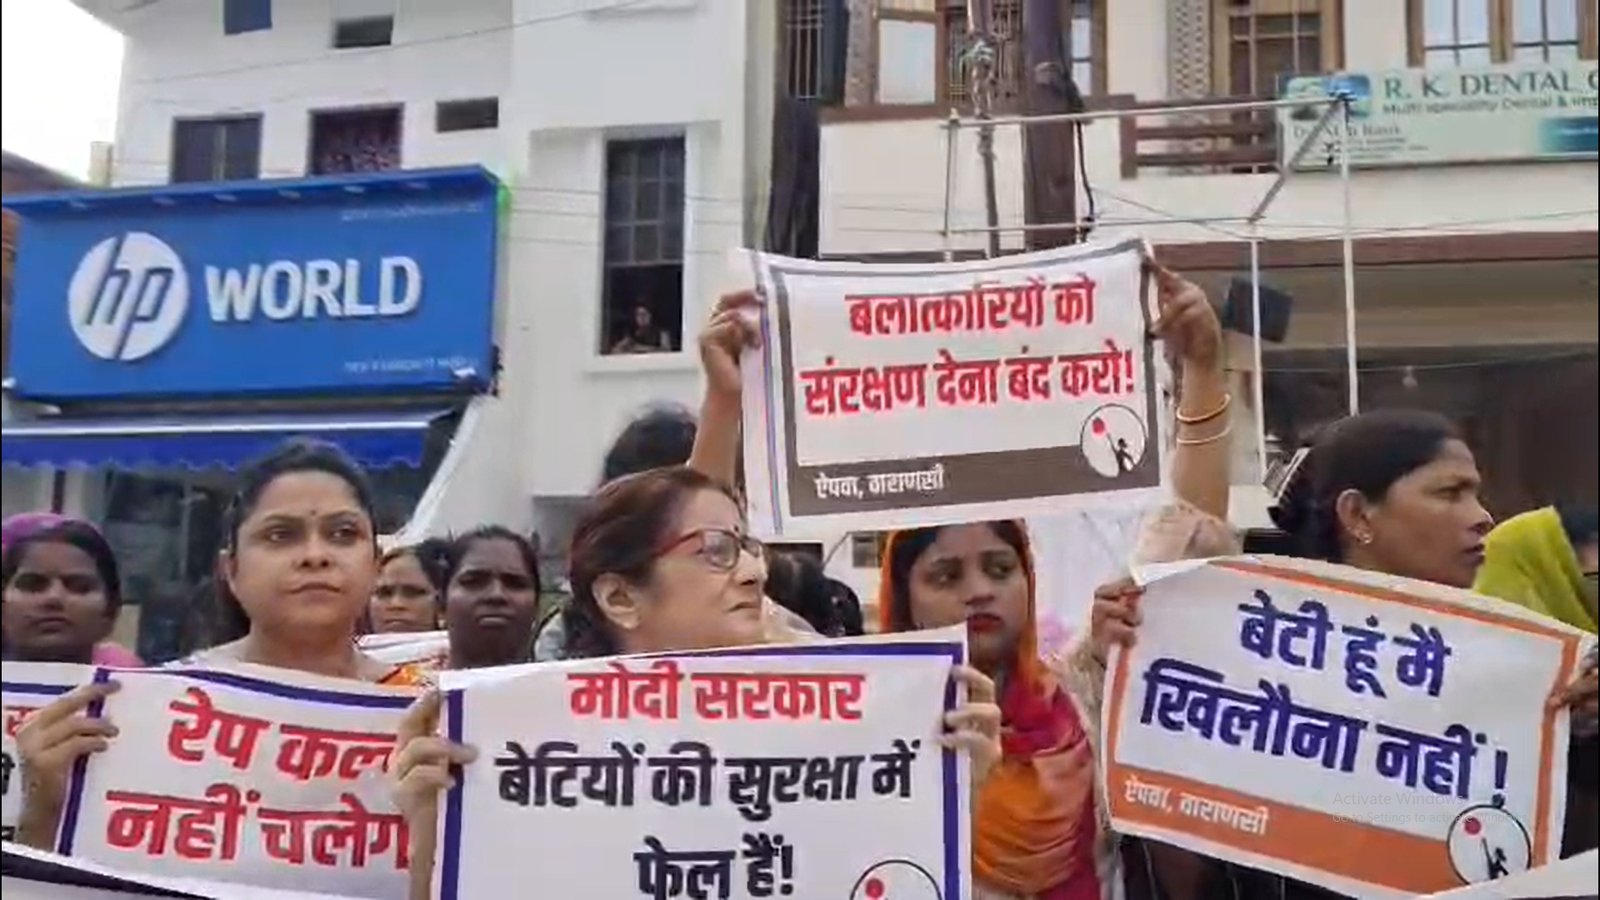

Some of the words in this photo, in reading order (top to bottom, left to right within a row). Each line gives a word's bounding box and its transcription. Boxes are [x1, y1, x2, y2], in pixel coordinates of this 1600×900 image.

[1460, 70, 1571, 95] DENTAL
[205, 256, 423, 322] WORLD
[845, 275, 1046, 336] बलात्कारियों
[1053, 272, 1097, 325] को
[800, 357, 927, 415] संरक्षण
[933, 348, 1000, 406] देना
[1005, 345, 1053, 400] बंद
[1060, 339, 1135, 397] करो!
[814, 471, 863, 499] ऐपवा,
[866, 463, 944, 494] वाराणसी
[1238, 588, 1335, 670] बेटी
[1341, 614, 1387, 699] हूं
[1392, 622, 1452, 698] मै
[568, 660, 684, 720] मोदी
[691, 673, 865, 721] सरकार
[168, 688, 272, 770] रेप
[1141, 657, 1368, 773] खिलौना
[1375, 723, 1487, 800] नहीं
[494, 741, 646, 808] बेटियों
[648, 741, 714, 807] की
[724, 755, 866, 822] सुरक्षा
[871, 739, 921, 799] में
[1124, 774, 1173, 813] ऐपवा,
[1178, 792, 1269, 836] वाराणसी
[106, 784, 260, 862] नहीं
[257, 794, 411, 870] चलेग
[633, 835, 737, 900] फेल
